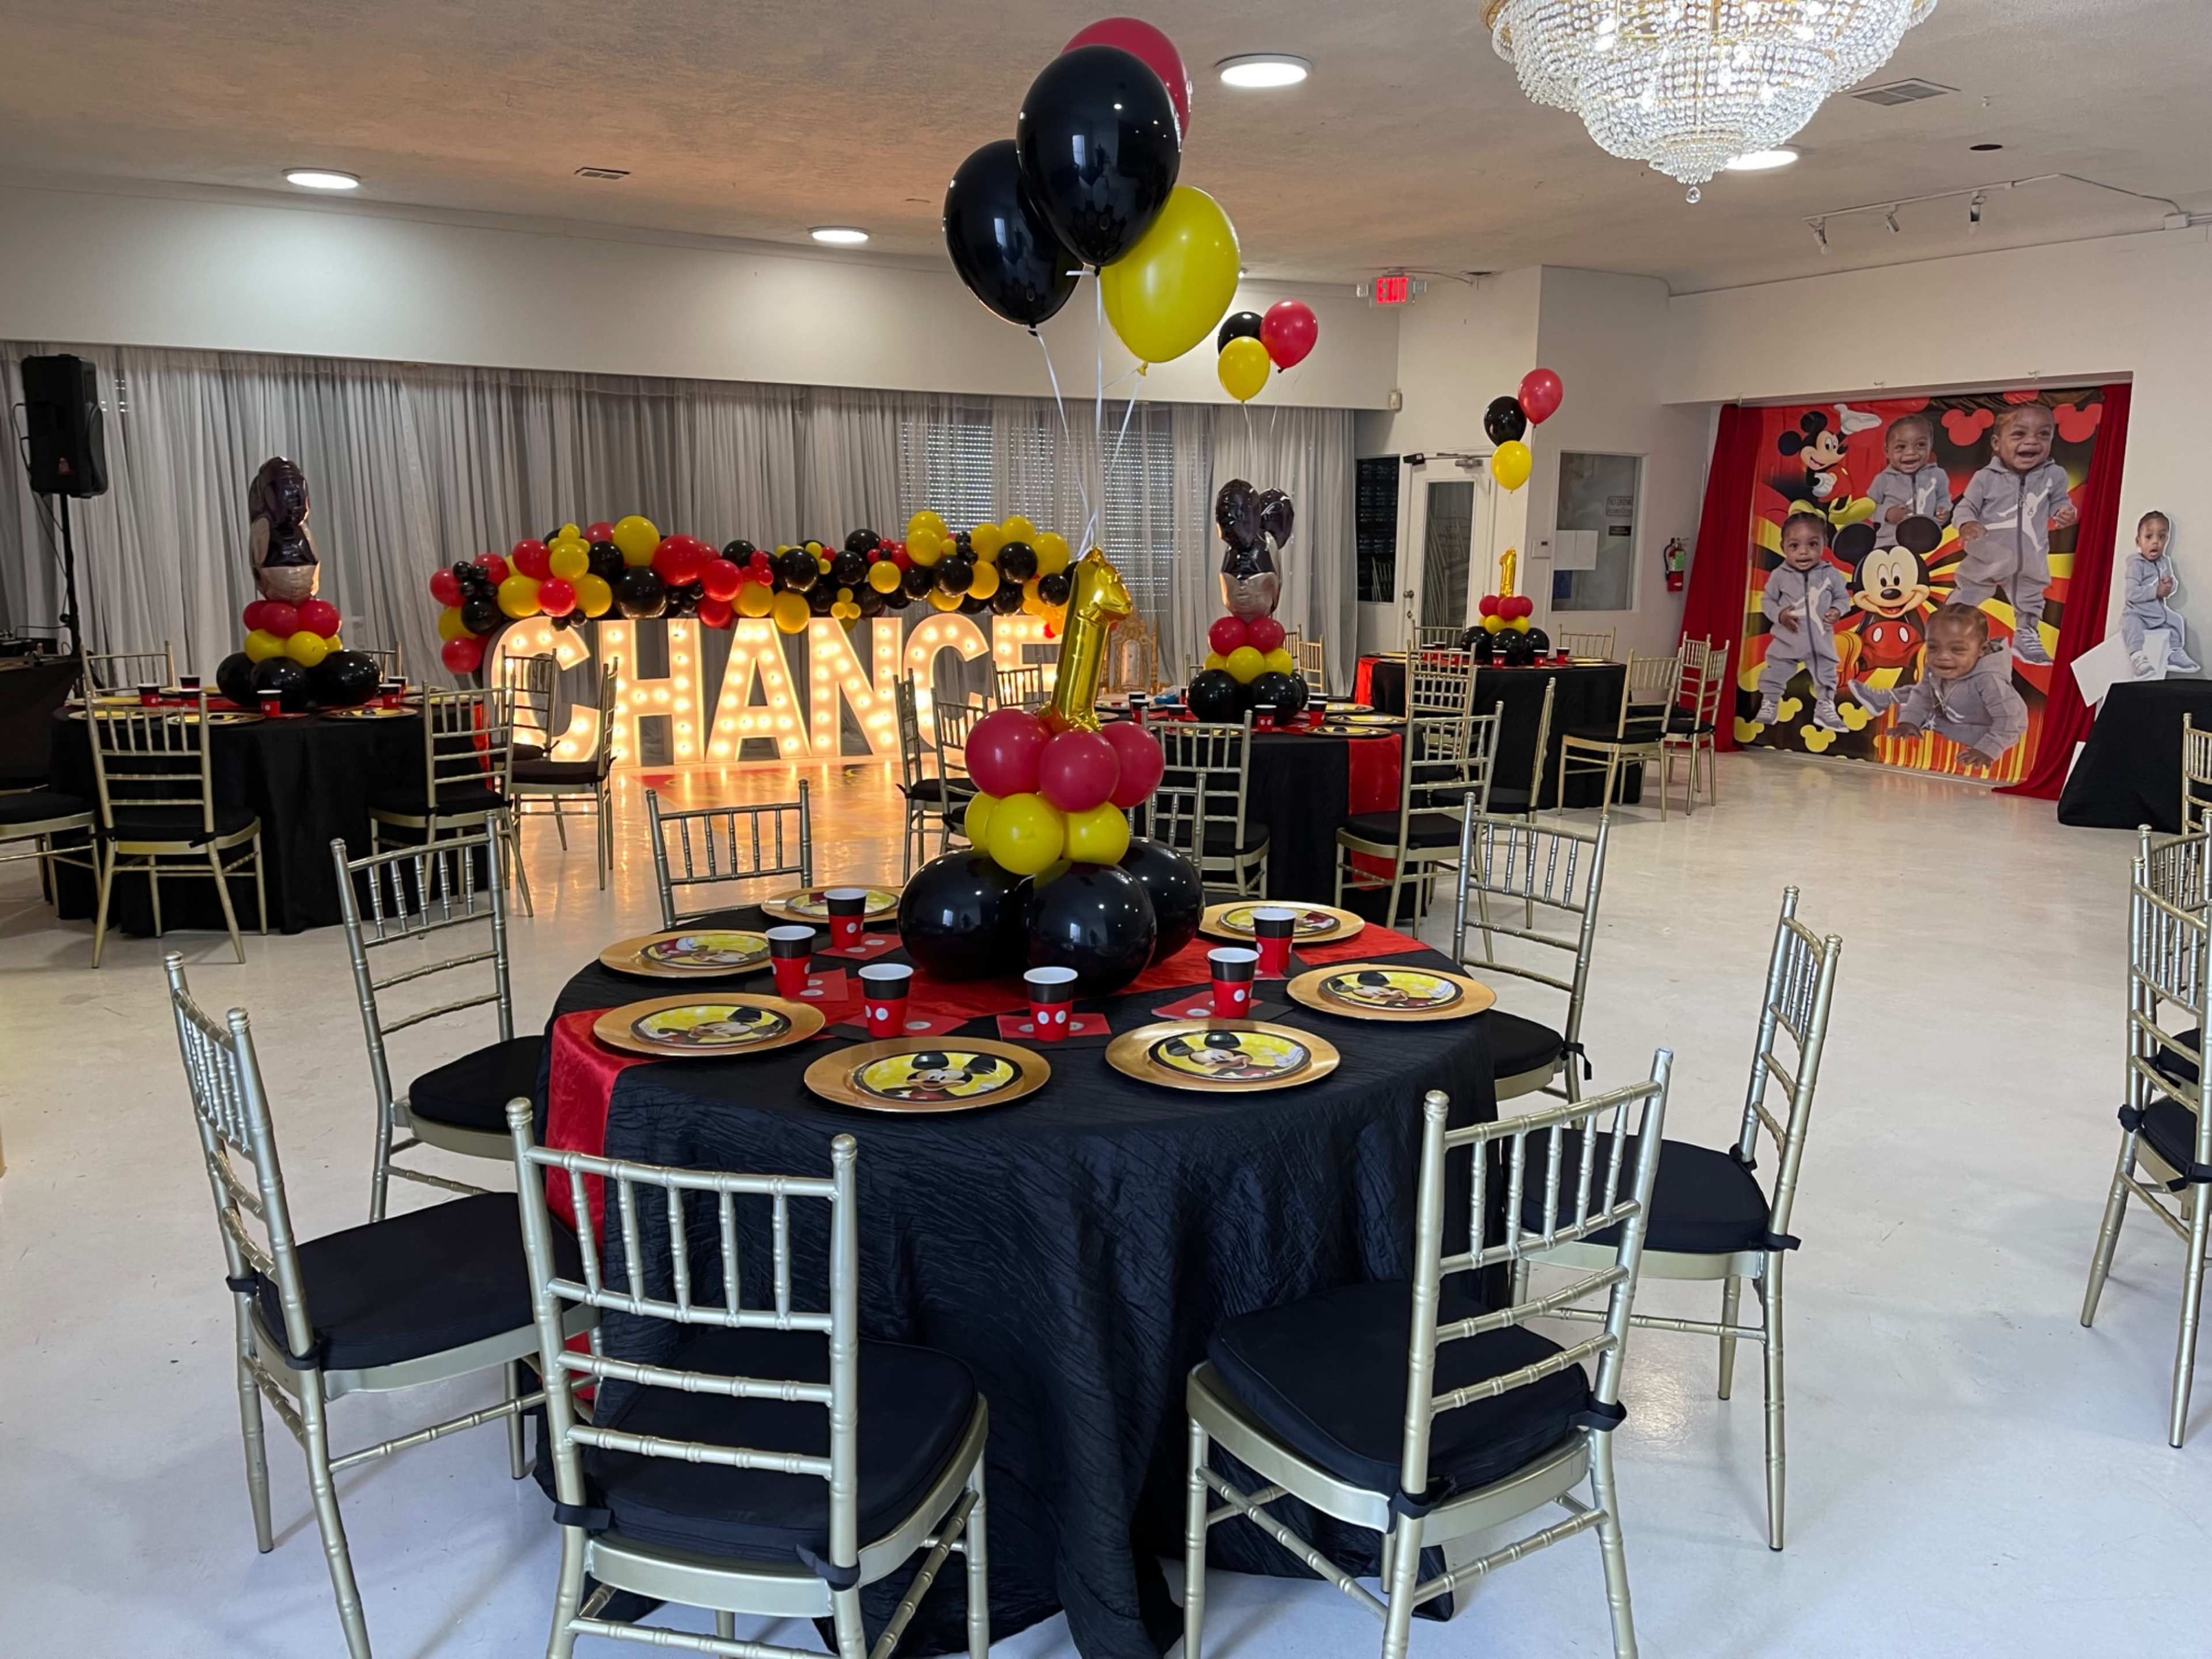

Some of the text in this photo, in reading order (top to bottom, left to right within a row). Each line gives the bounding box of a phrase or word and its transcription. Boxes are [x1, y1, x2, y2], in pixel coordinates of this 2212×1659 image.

[1377, 277, 1408, 304] EXIT
[1499, 547, 1517, 598] 1
[487, 612, 1063, 767] CHANCE
